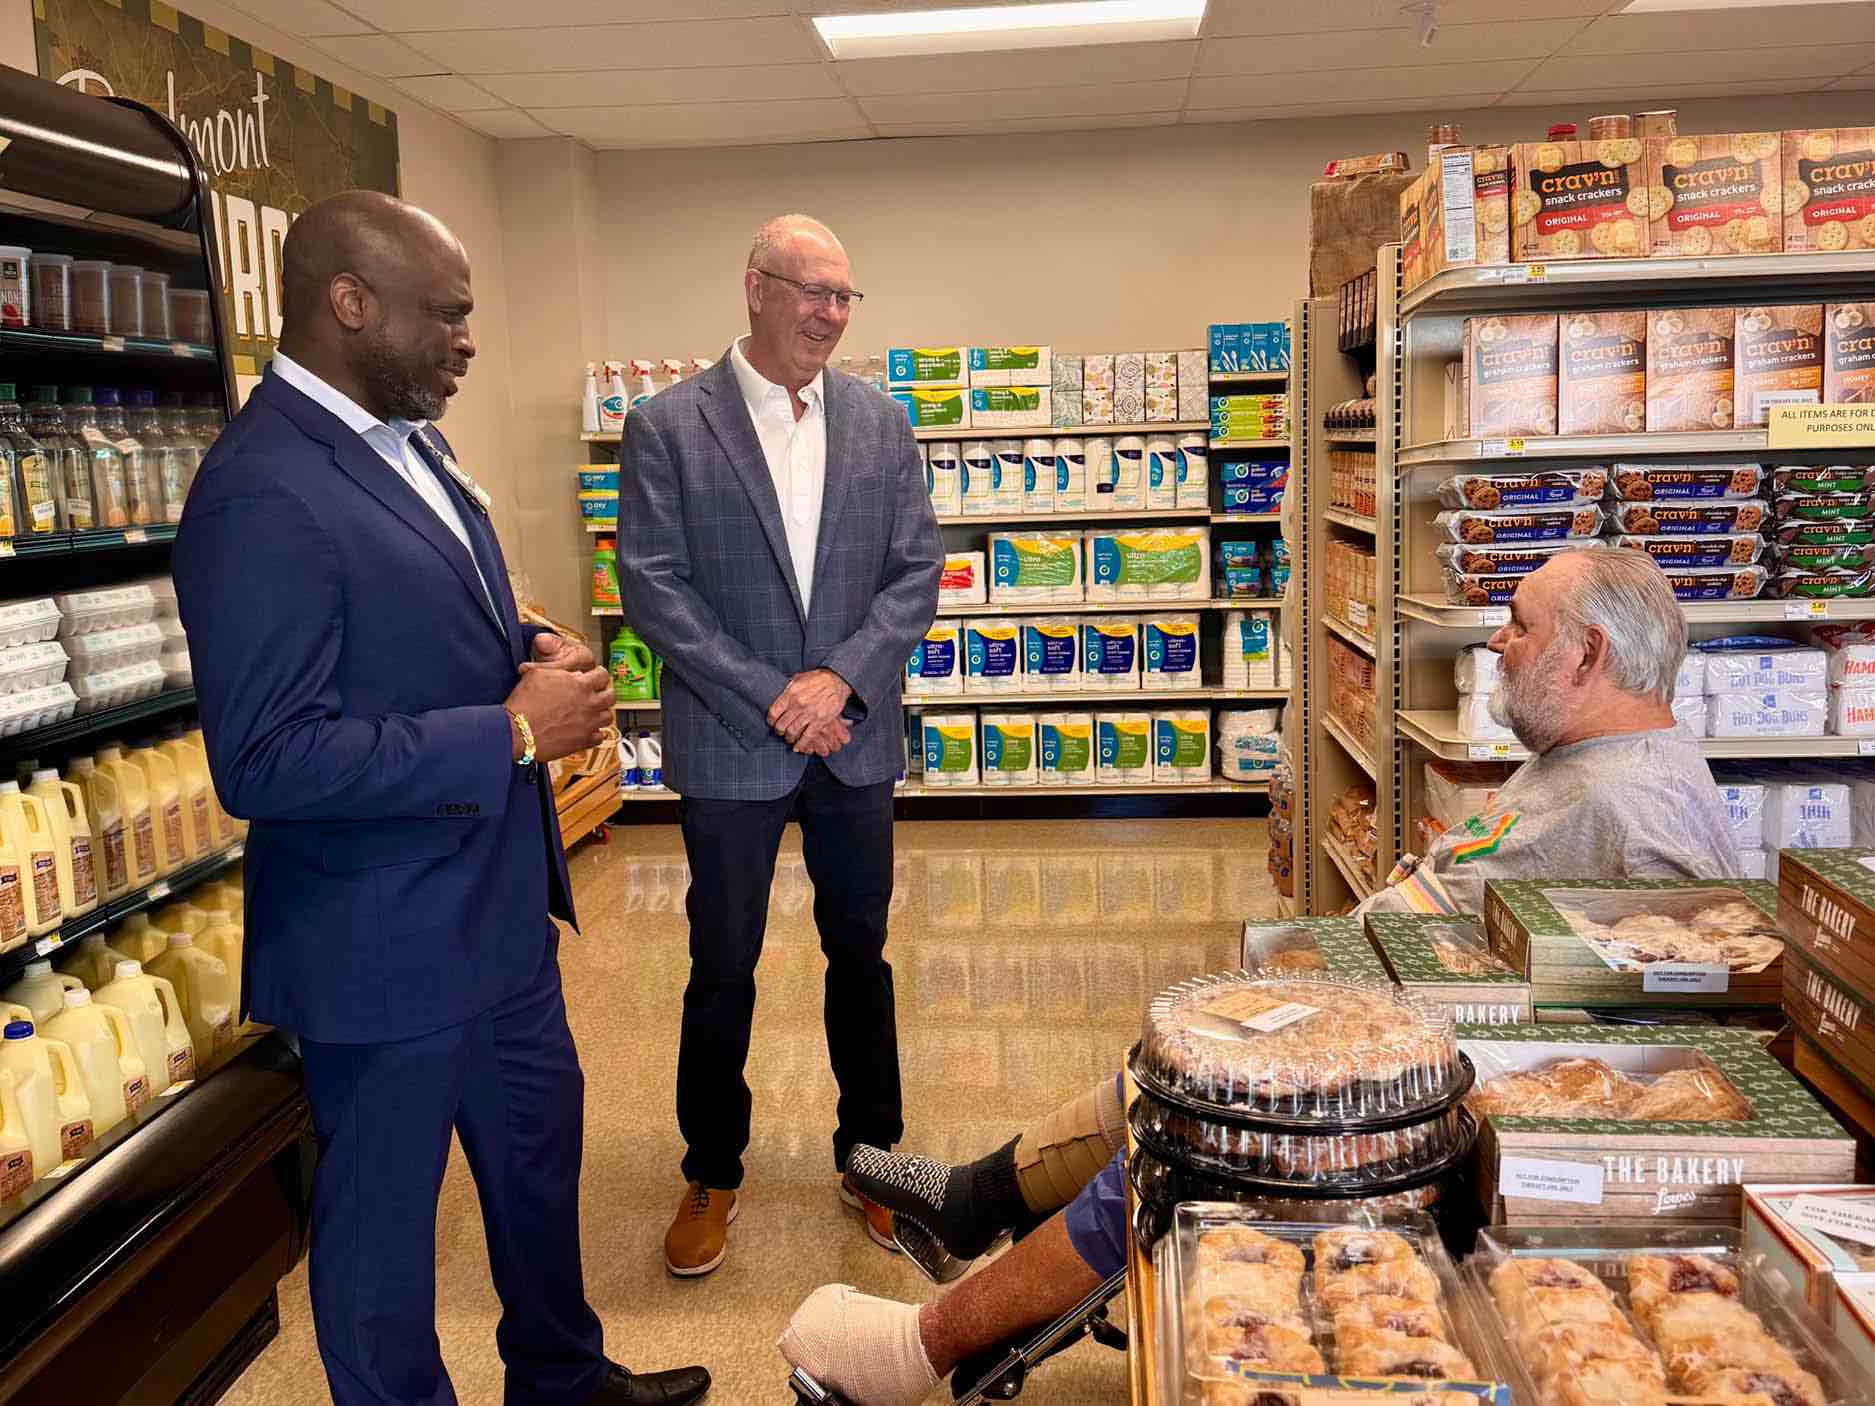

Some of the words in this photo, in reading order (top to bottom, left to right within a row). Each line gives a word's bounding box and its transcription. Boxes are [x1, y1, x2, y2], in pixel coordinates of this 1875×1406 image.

[1674, 164, 1748, 189] crav'n
[1810, 160, 1875, 183] crav'
[1541, 170, 1615, 193] crav'n
[1813, 184, 1845, 196] snack
[1846, 180, 1875, 192] crack
[1545, 192, 1576, 206] snack
[1577, 186, 1623, 200] crackers
[1677, 190, 1709, 202] snack
[1710, 182, 1756, 198] crackers
[1545, 214, 1587, 227] ORIGINAL
[1676, 212, 1721, 224] ORIGINAL
[1811, 206, 1857, 218] ORIGINAL
[1746, 336, 1811, 357] crav'n
[1748, 357, 1780, 369] graham
[1781, 352, 1816, 364] crackers
[1839, 354, 1870, 366] graham
[1782, 411, 1798, 419] ALL
[1800, 410, 1828, 418] ITEMS
[1829, 410, 1849, 418] ARE
[1850, 409, 1869, 418] FOR
[1806, 424, 1855, 432] PURPOSES
[1856, 423, 1875, 432] ONL
[1502, 493, 1540, 501] ORIGINAL
[1654, 488, 1690, 496] ORIGINAL
[1495, 531, 1533, 540] ORIGINAL
[1497, 565, 1534, 573] ORIGINAL
[1847, 706, 1875, 724] HAM
[1819, 896, 1857, 941] BAKERY
[1455, 1004, 1521, 1025] BAKERY
[1823, 983, 1863, 1032] BAKERY
[1603, 1155, 1646, 1183] THE
[1655, 1156, 1745, 1185] BAKERY
